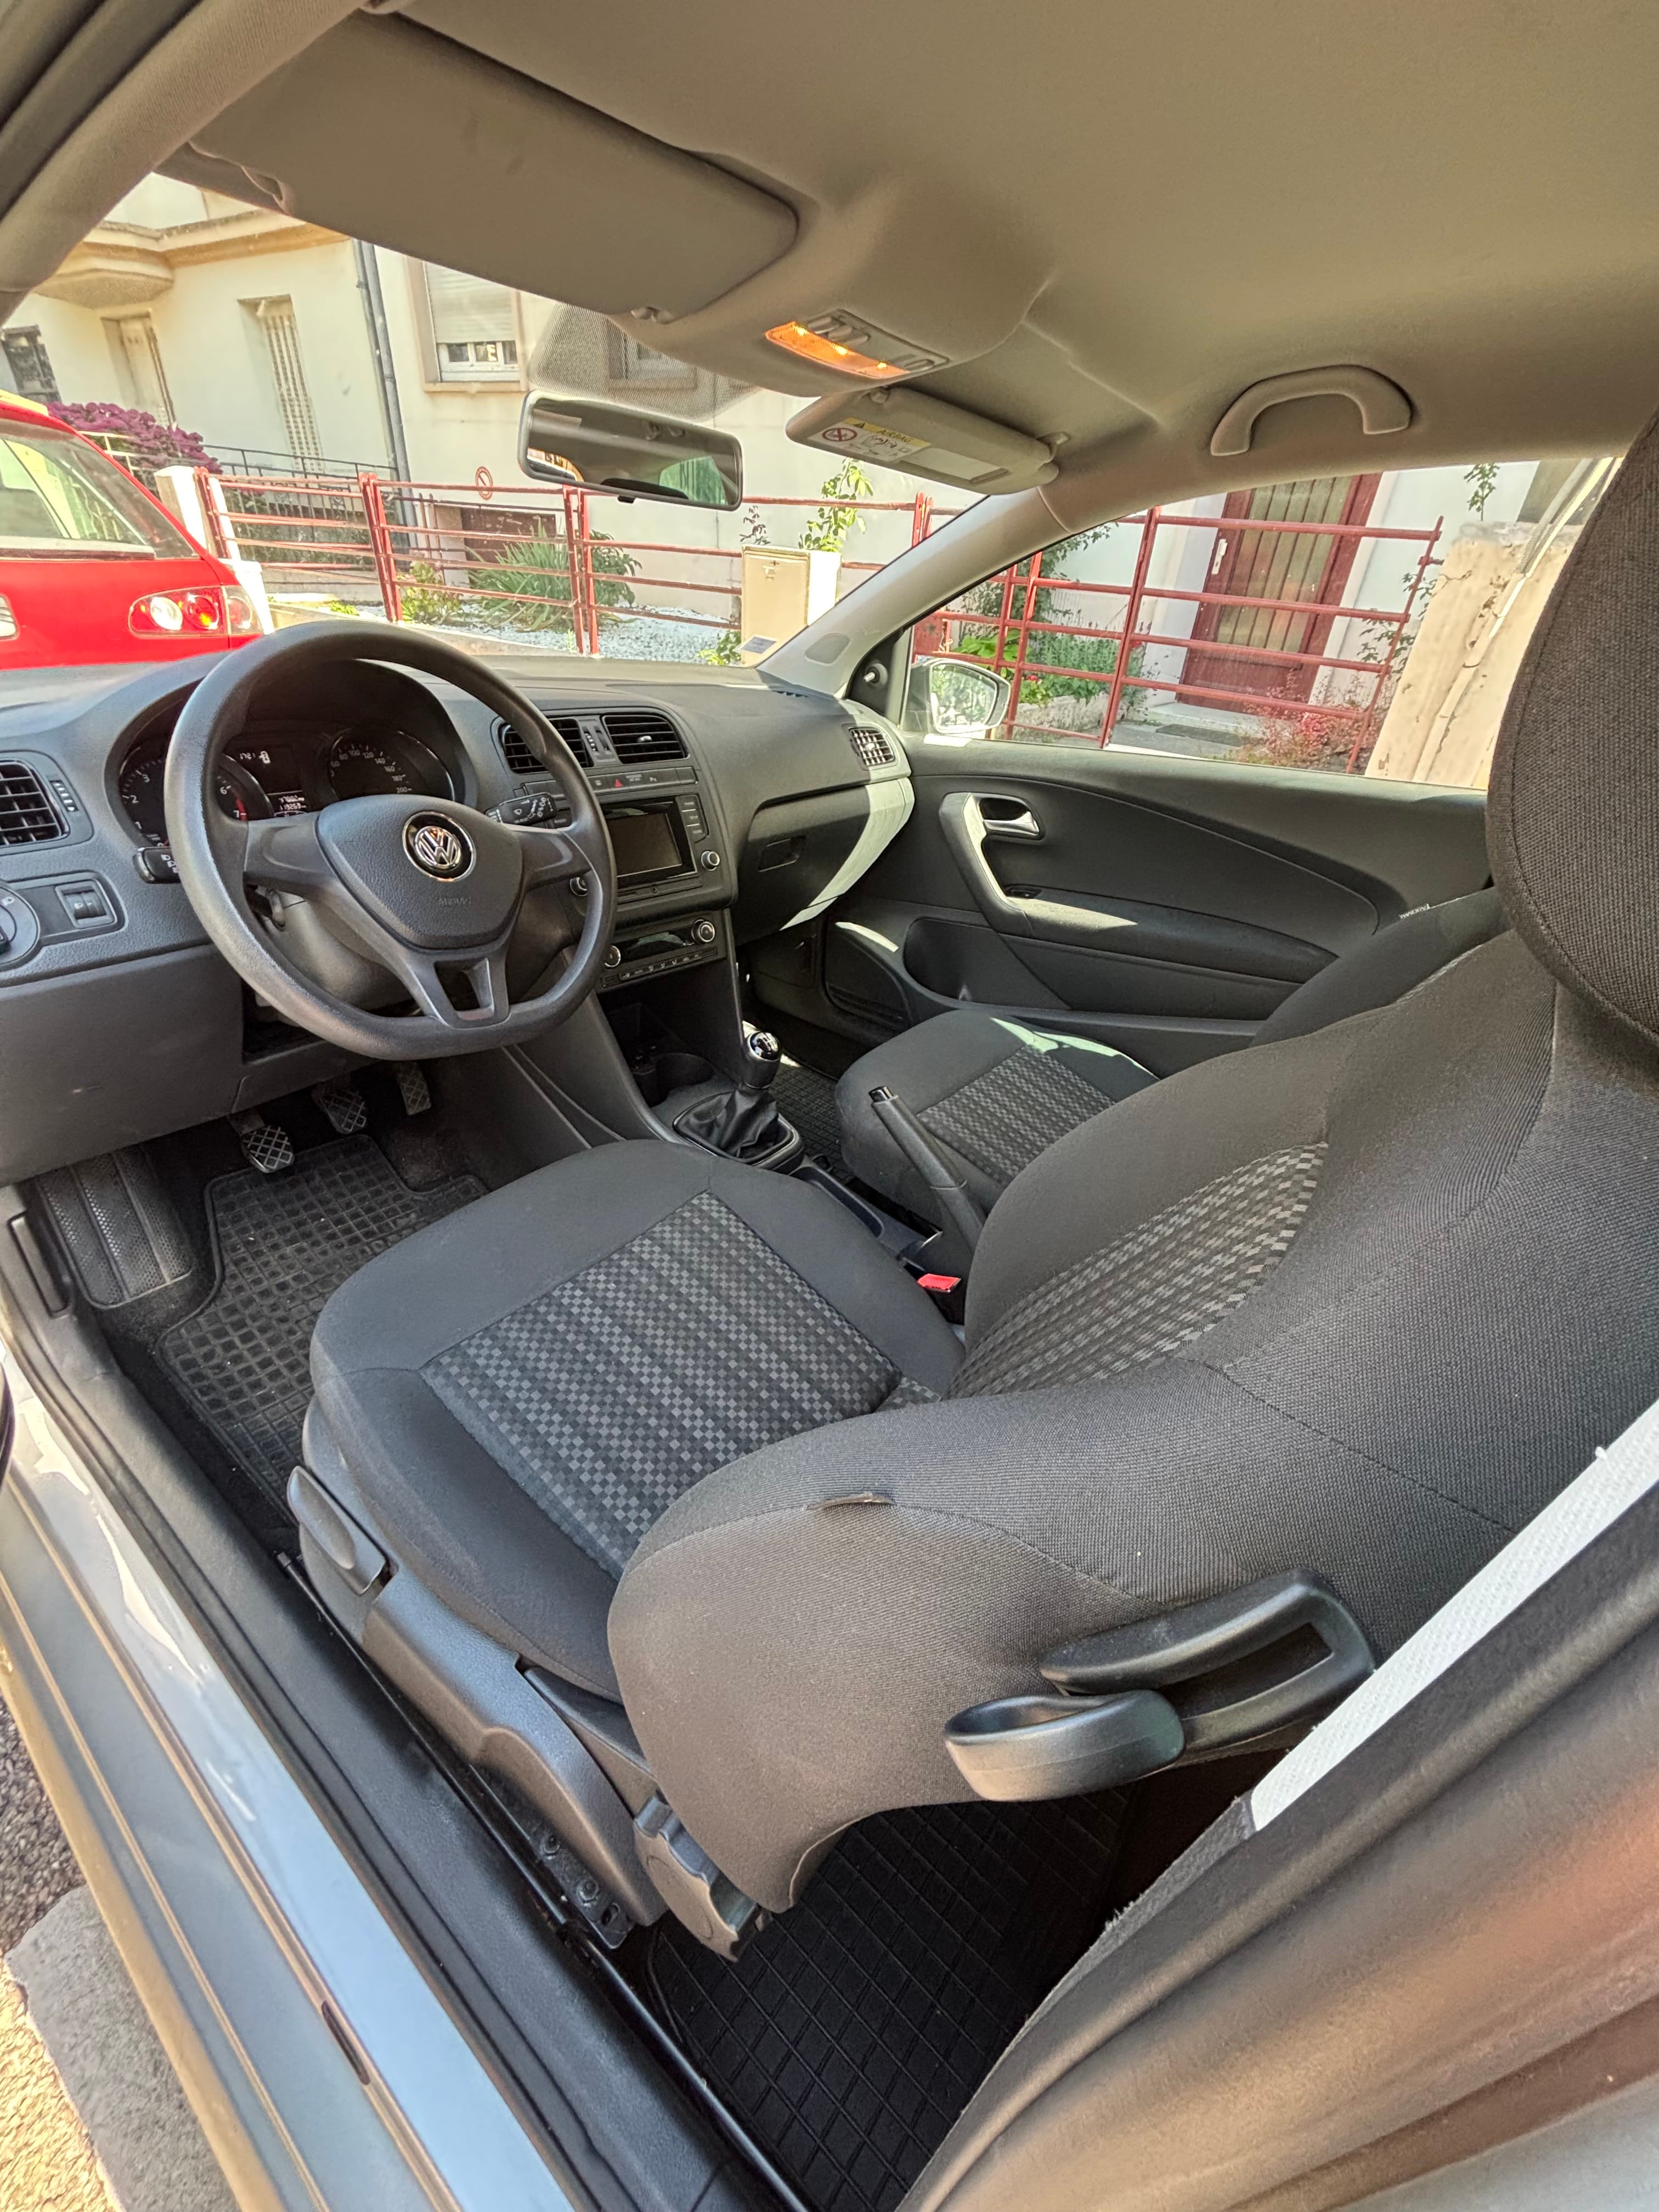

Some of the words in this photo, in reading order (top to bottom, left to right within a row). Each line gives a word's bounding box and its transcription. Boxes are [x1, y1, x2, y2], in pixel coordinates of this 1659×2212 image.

[142, 774, 150, 782] 3
[220, 786, 228, 794] 6
[130, 795, 139, 803] 2
[233, 810, 240, 818] 7
